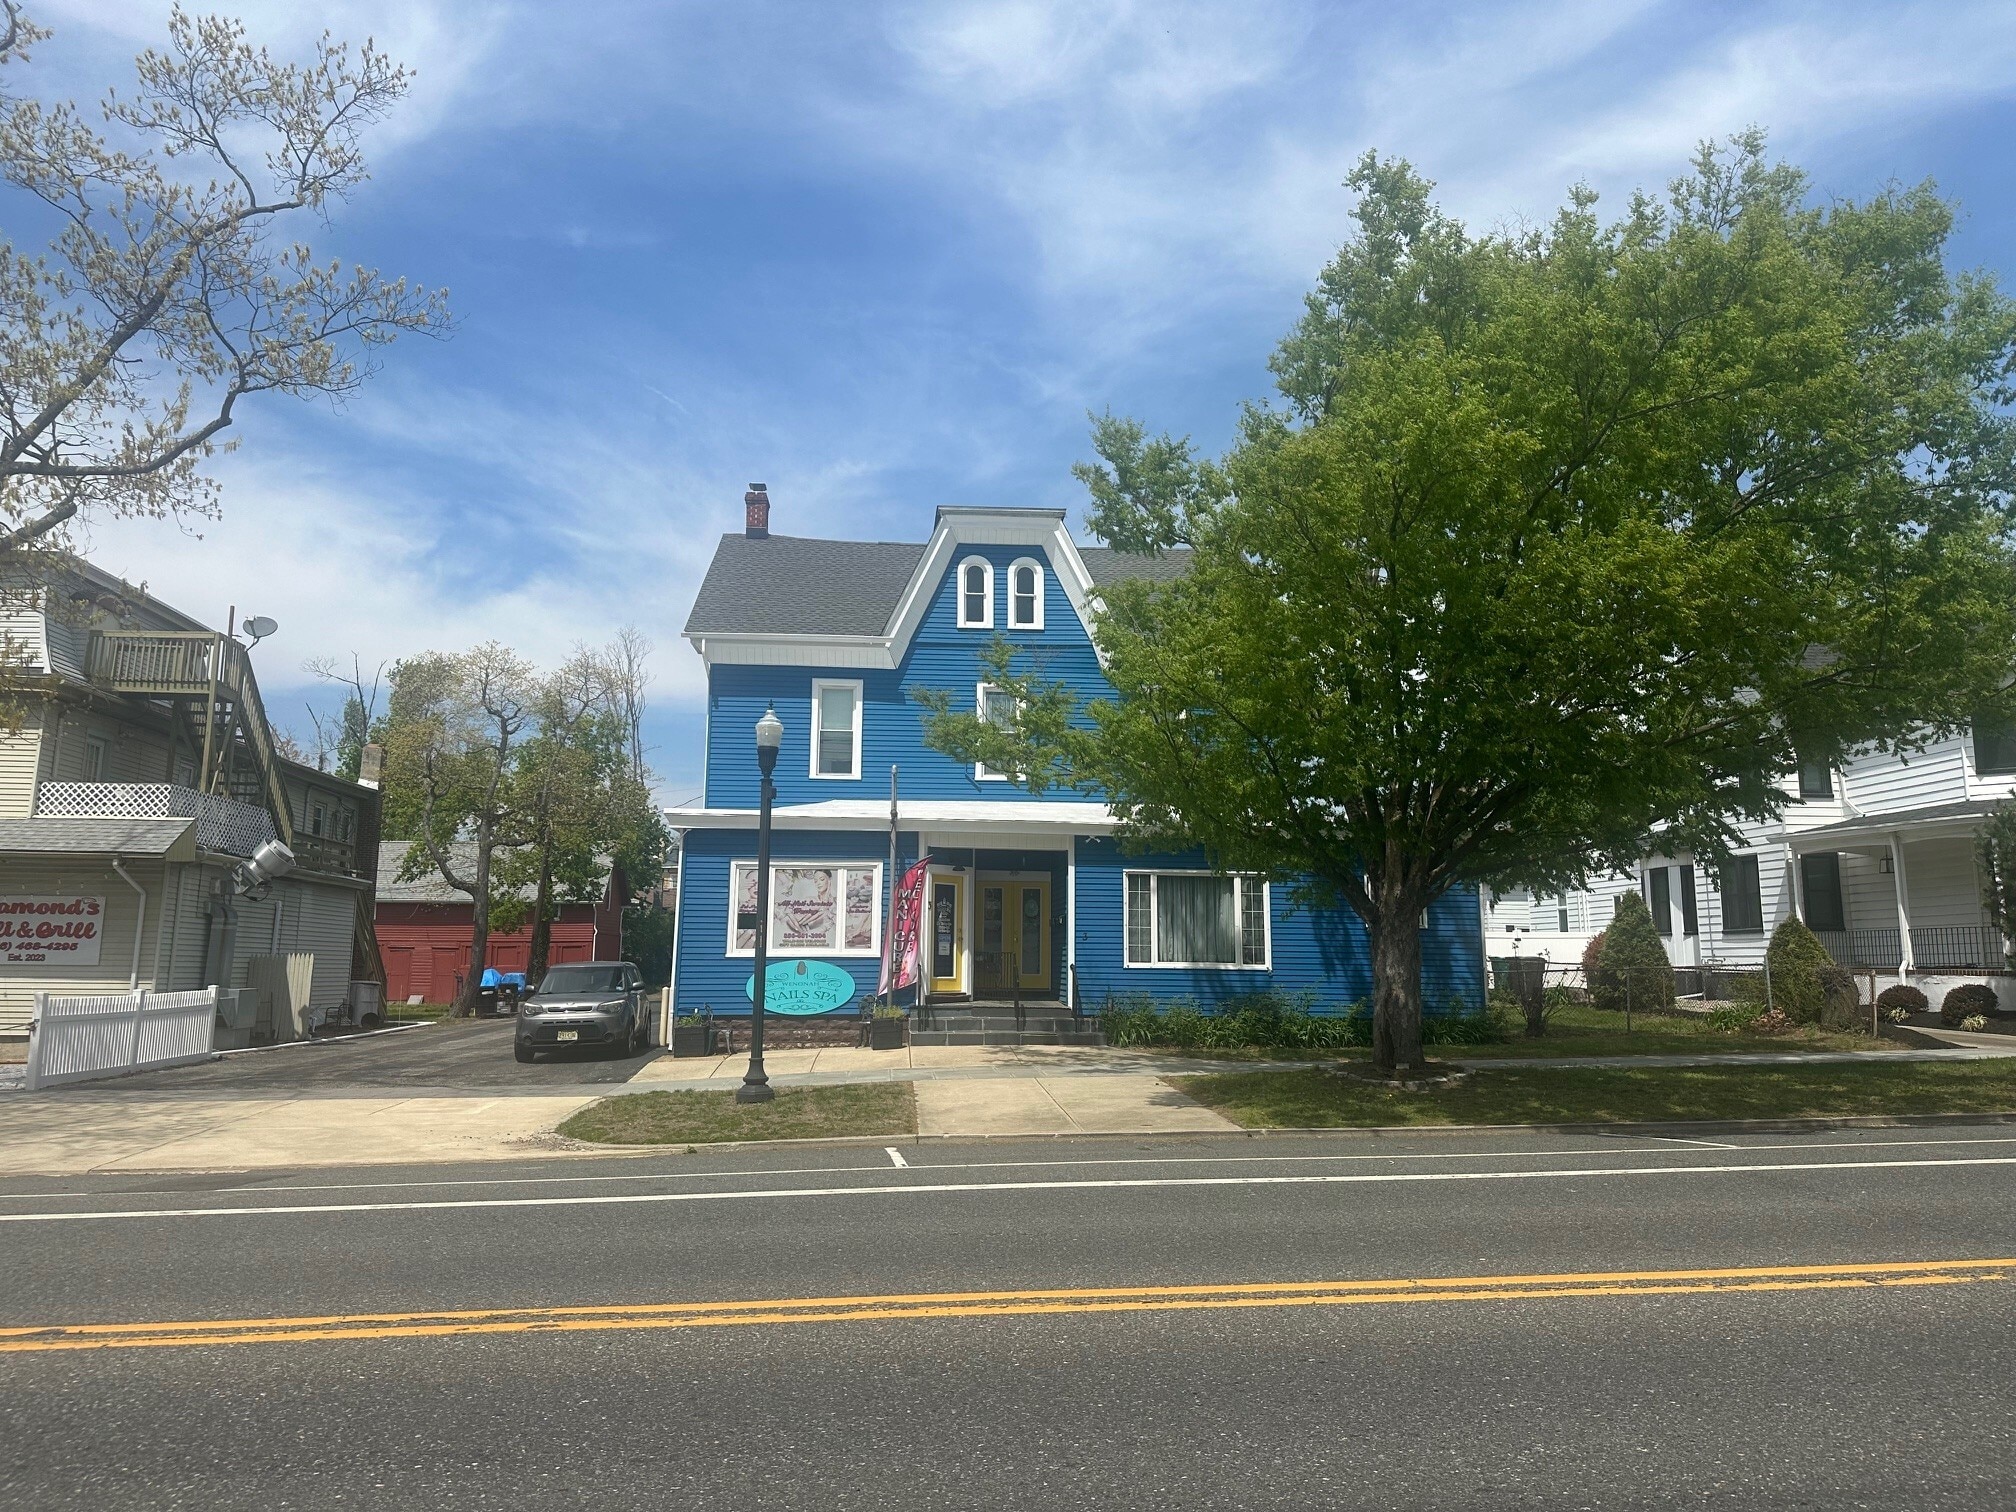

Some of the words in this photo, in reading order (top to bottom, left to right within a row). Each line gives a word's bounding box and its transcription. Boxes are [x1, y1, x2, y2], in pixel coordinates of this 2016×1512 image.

[16, 921, 35, 938] &
[35, 921, 97, 939] Grill
[893, 888, 912, 973] MANICURE
[7, 953, 23, 961] Est.
[24, 953, 46, 961] 2023
[765, 989, 810, 1003] NAILS
[812, 989, 837, 1003] SPA
